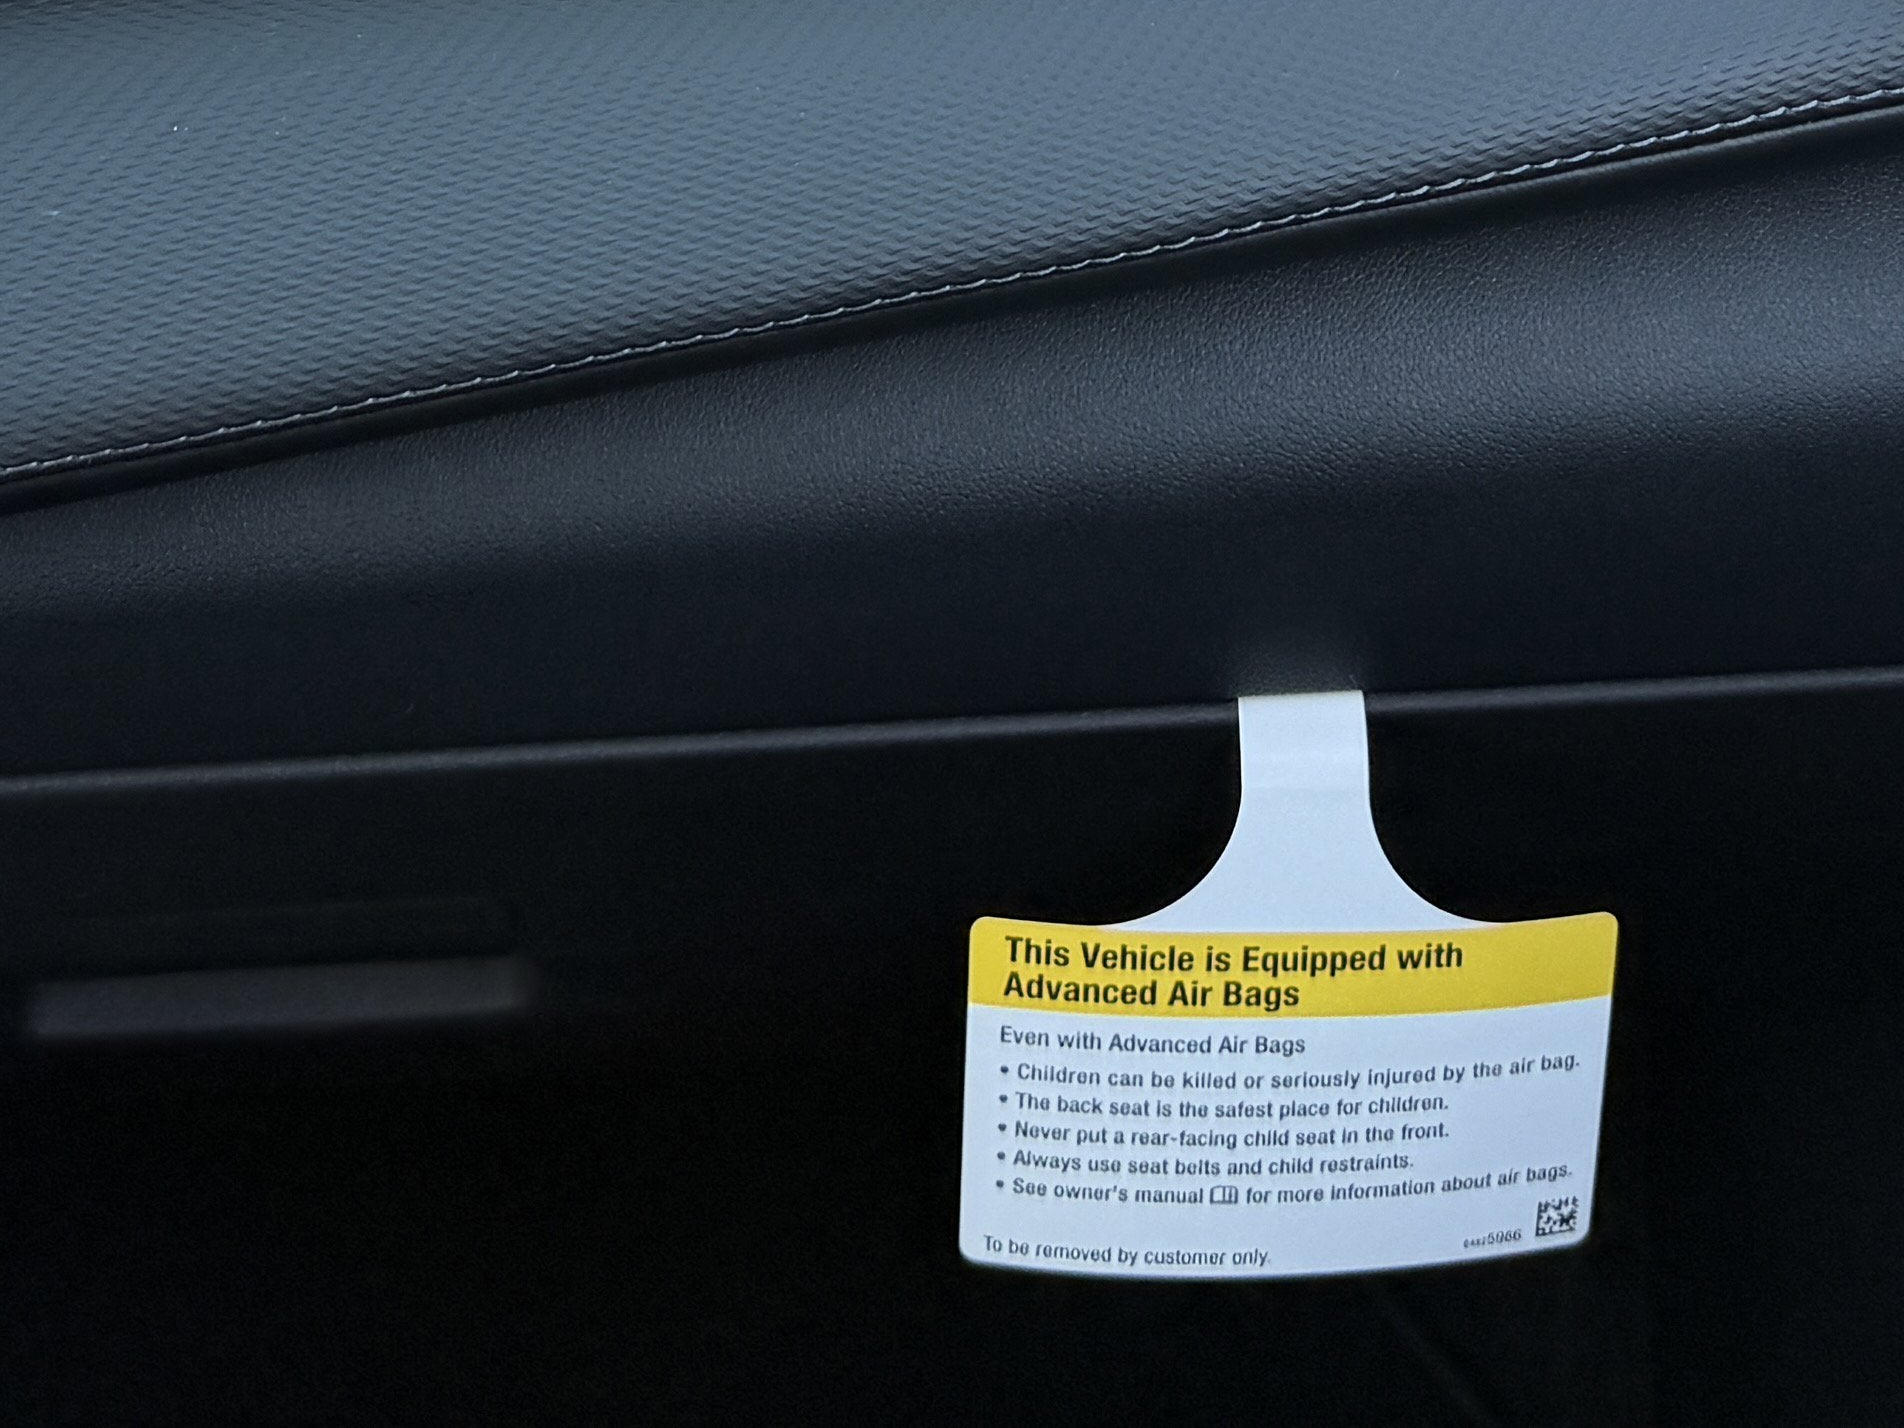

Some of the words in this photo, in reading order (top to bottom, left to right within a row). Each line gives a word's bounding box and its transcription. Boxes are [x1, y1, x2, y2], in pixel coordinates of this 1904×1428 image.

[1004, 936, 1070, 967] This
[1081, 941, 1194, 972] Vehicle
[1206, 946, 1231, 972] is
[1242, 945, 1386, 977] Equipped
[1397, 942, 1463, 969] with
[1003, 971, 1157, 1006] Advanced
[1168, 980, 1213, 1006] Air
[1223, 981, 1300, 1012] Bags
[1000, 1025, 1049, 1048] Even
[1057, 1030, 1101, 1050] with
[1108, 1033, 1211, 1054] Advanced
[1218, 1035, 1247, 1054] Air
[1255, 1036, 1306, 1057] Bags
[1017, 1062, 1101, 1085] Children
[1108, 1073, 1144, 1087] can
[1151, 1071, 1175, 1088] be
[1182, 1072, 1236, 1089] killed
[1244, 1075, 1264, 1089] or
[1271, 1070, 1360, 1089] seriously
[1368, 1065, 1436, 1088] injured
[1443, 1064, 1465, 1083] by
[1473, 1062, 1502, 1078] the
[1509, 1057, 1535, 1075] air
[1541, 1054, 1580, 1072] bag.
[1015, 1091, 1050, 1111] The
[1057, 1096, 1103, 1114] back
[1109, 1099, 1150, 1116] seat
[1157, 1100, 1172, 1117] is
[1179, 1101, 1208, 1117] the
[1215, 1101, 1273, 1118] safest
[1279, 1101, 1330, 1121] place
[1337, 1099, 1362, 1116] for
[1368, 1095, 1449, 1114] children.
[1014, 1120, 1071, 1141] Never
[1076, 1128, 1107, 1145] put
[1113, 1131, 1125, 1144] a
[1131, 1129, 1237, 1150] rear-facing
[1243, 1129, 1289, 1146] child
[1296, 1128, 1335, 1145] seat
[1342, 1127, 1358, 1143] in
[1365, 1126, 1394, 1141] the
[1401, 1122, 1449, 1140] front.
[1013, 1149, 1081, 1173] Always
[1088, 1159, 1121, 1173] use
[1128, 1158, 1168, 1175] seat
[1175, 1159, 1221, 1175] belts
[1227, 1158, 1262, 1175] and
[1268, 1157, 1313, 1174] child
[1320, 1153, 1414, 1173] restraints.
[1012, 1178, 1047, 1196] See
[1053, 1185, 1128, 1202] owner's
[1135, 1188, 1203, 1204] manual
[1246, 1187, 1271, 1204] for
[1277, 1188, 1324, 1202] more
[1331, 1179, 1435, 1201] information
[1441, 1172, 1491, 1192] about
[1498, 1168, 1521, 1186] air
[1526, 1164, 1573, 1183] bags.
[984, 1234, 1003, 1253] To
[1008, 1238, 1029, 1256] be
[1035, 1243, 1112, 1263] removed
[1118, 1247, 1138, 1266] by
[1144, 1248, 1227, 1266] customer
